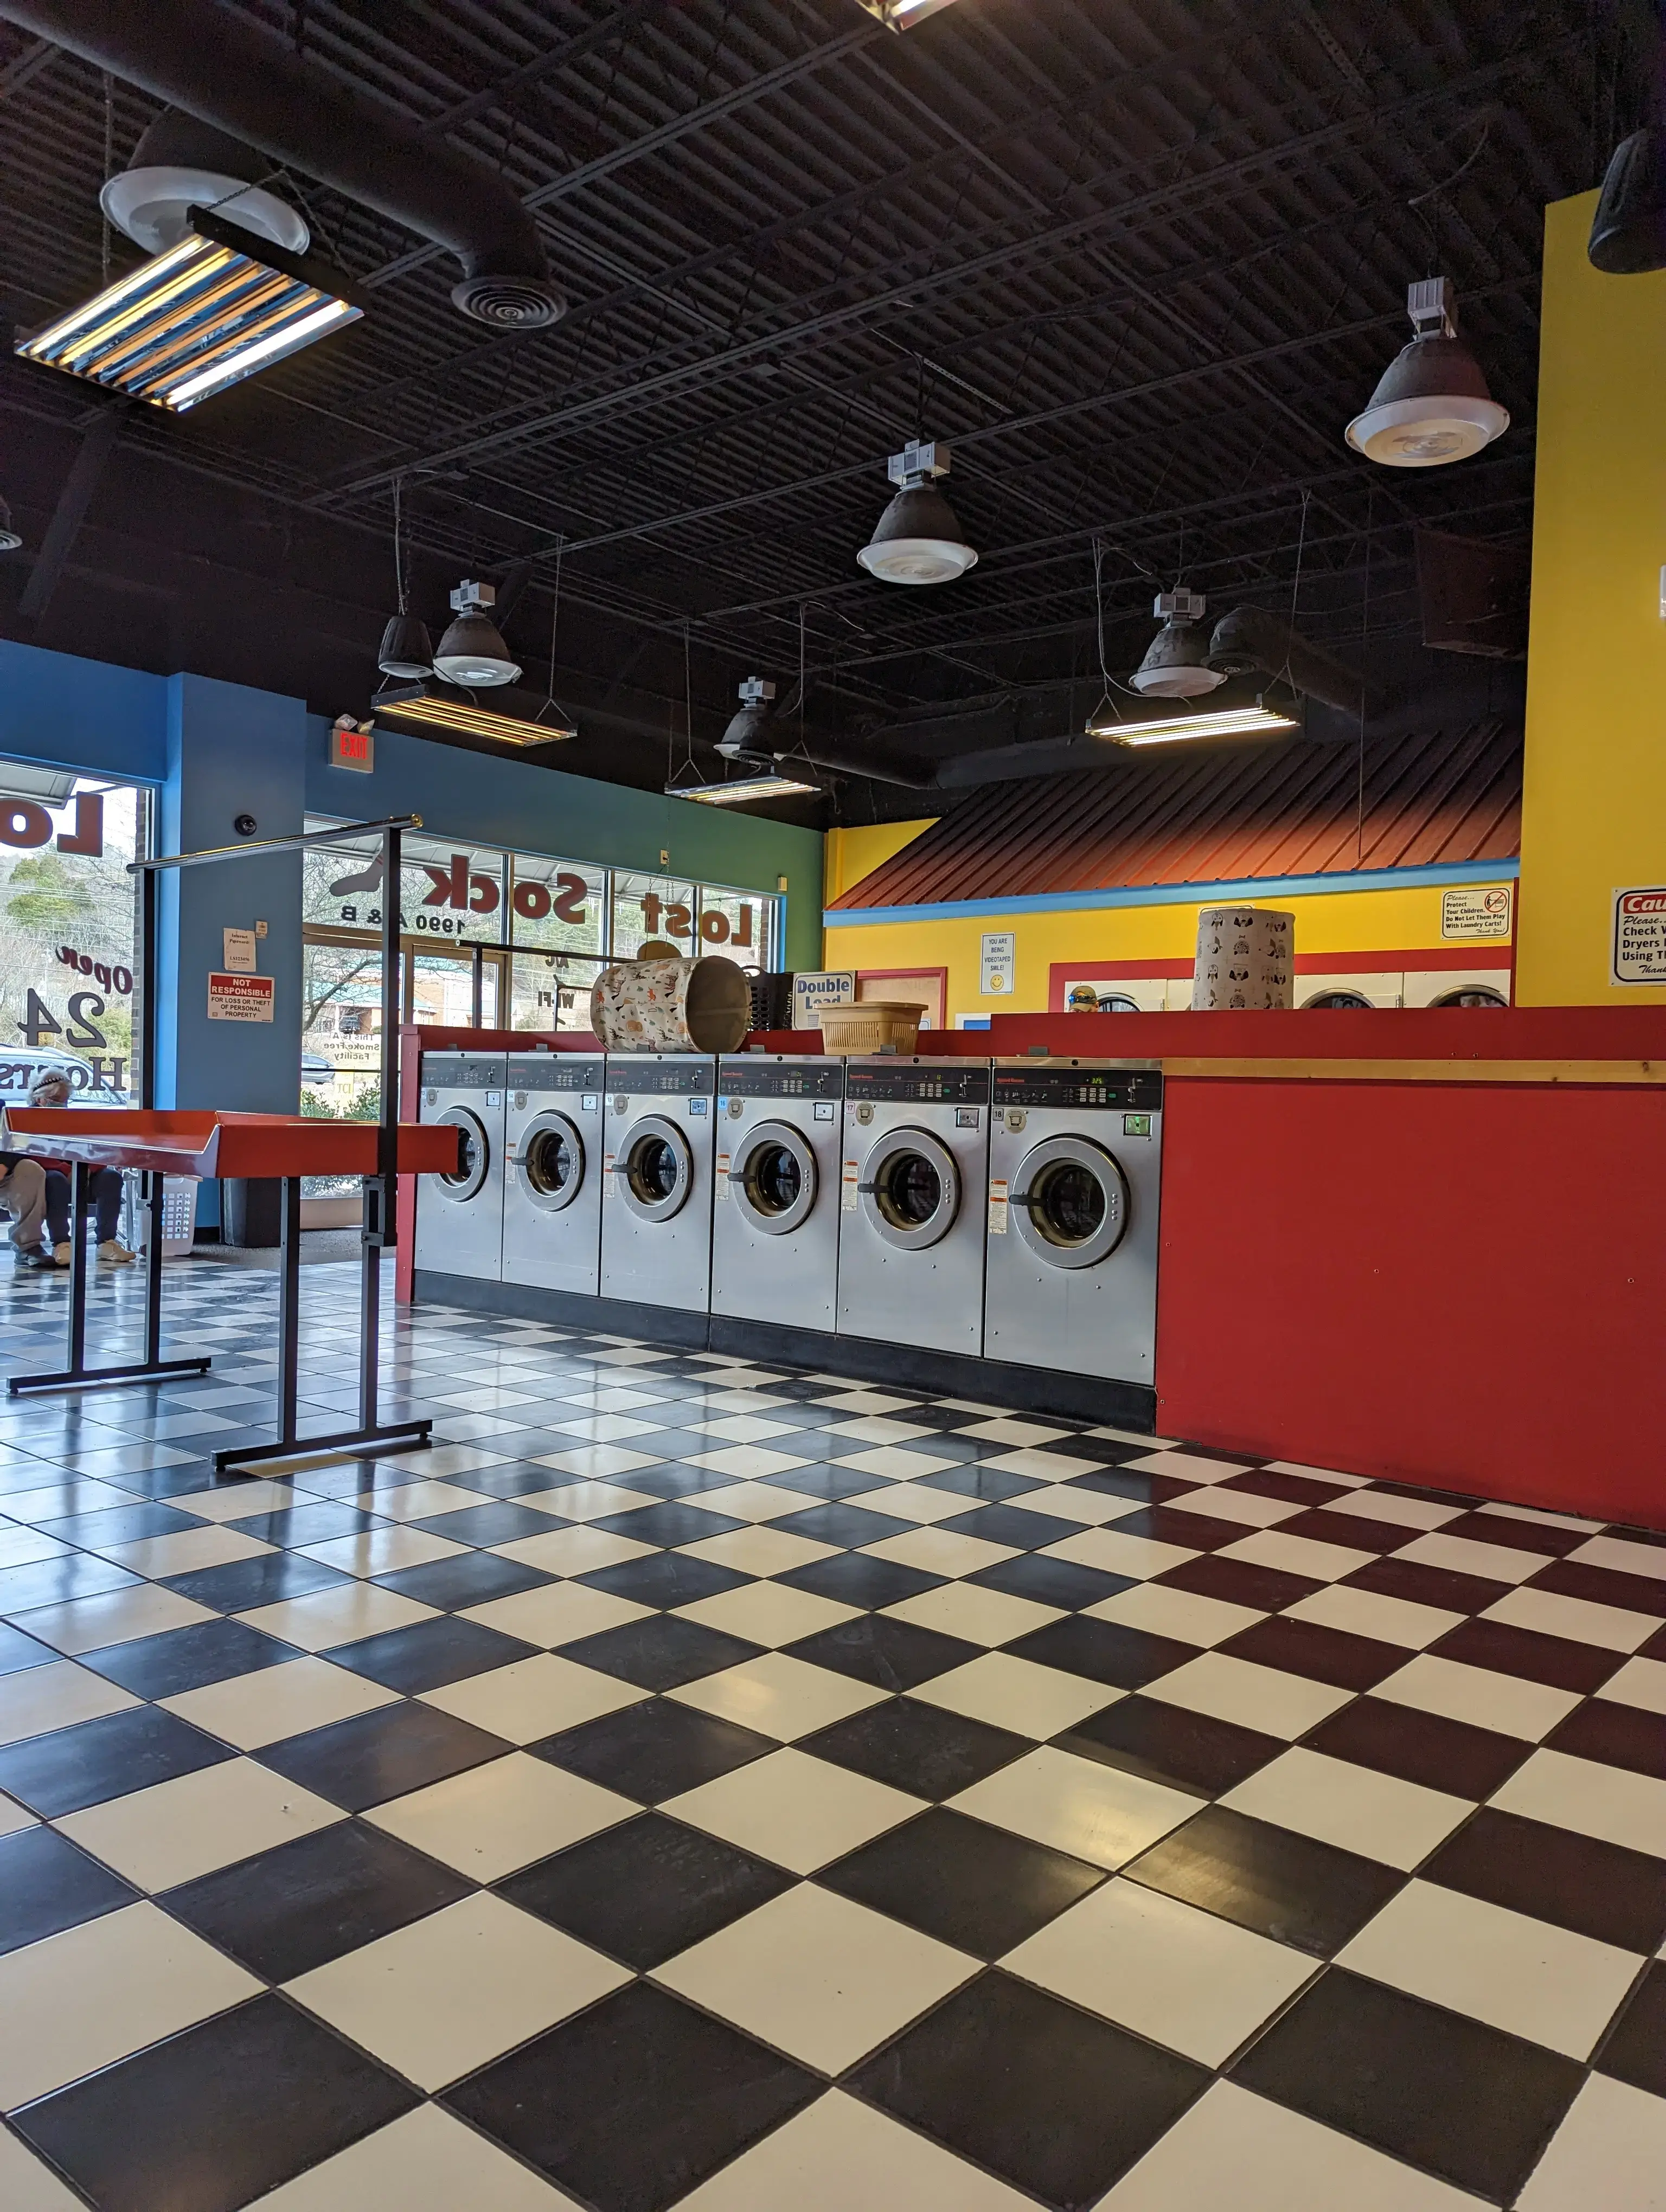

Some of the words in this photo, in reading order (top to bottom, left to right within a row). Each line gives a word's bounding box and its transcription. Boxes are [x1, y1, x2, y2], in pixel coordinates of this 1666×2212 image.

[341, 732, 367, 759] EXIT
[1623, 926, 1657, 936] Check
[1623, 940, 1659, 949] Dryers
[1623, 951, 1653, 962] Using
[233, 979, 251, 987] NOT
[798, 978, 849, 993] Double
[212, 986, 271, 997] RESPONSIBLE
